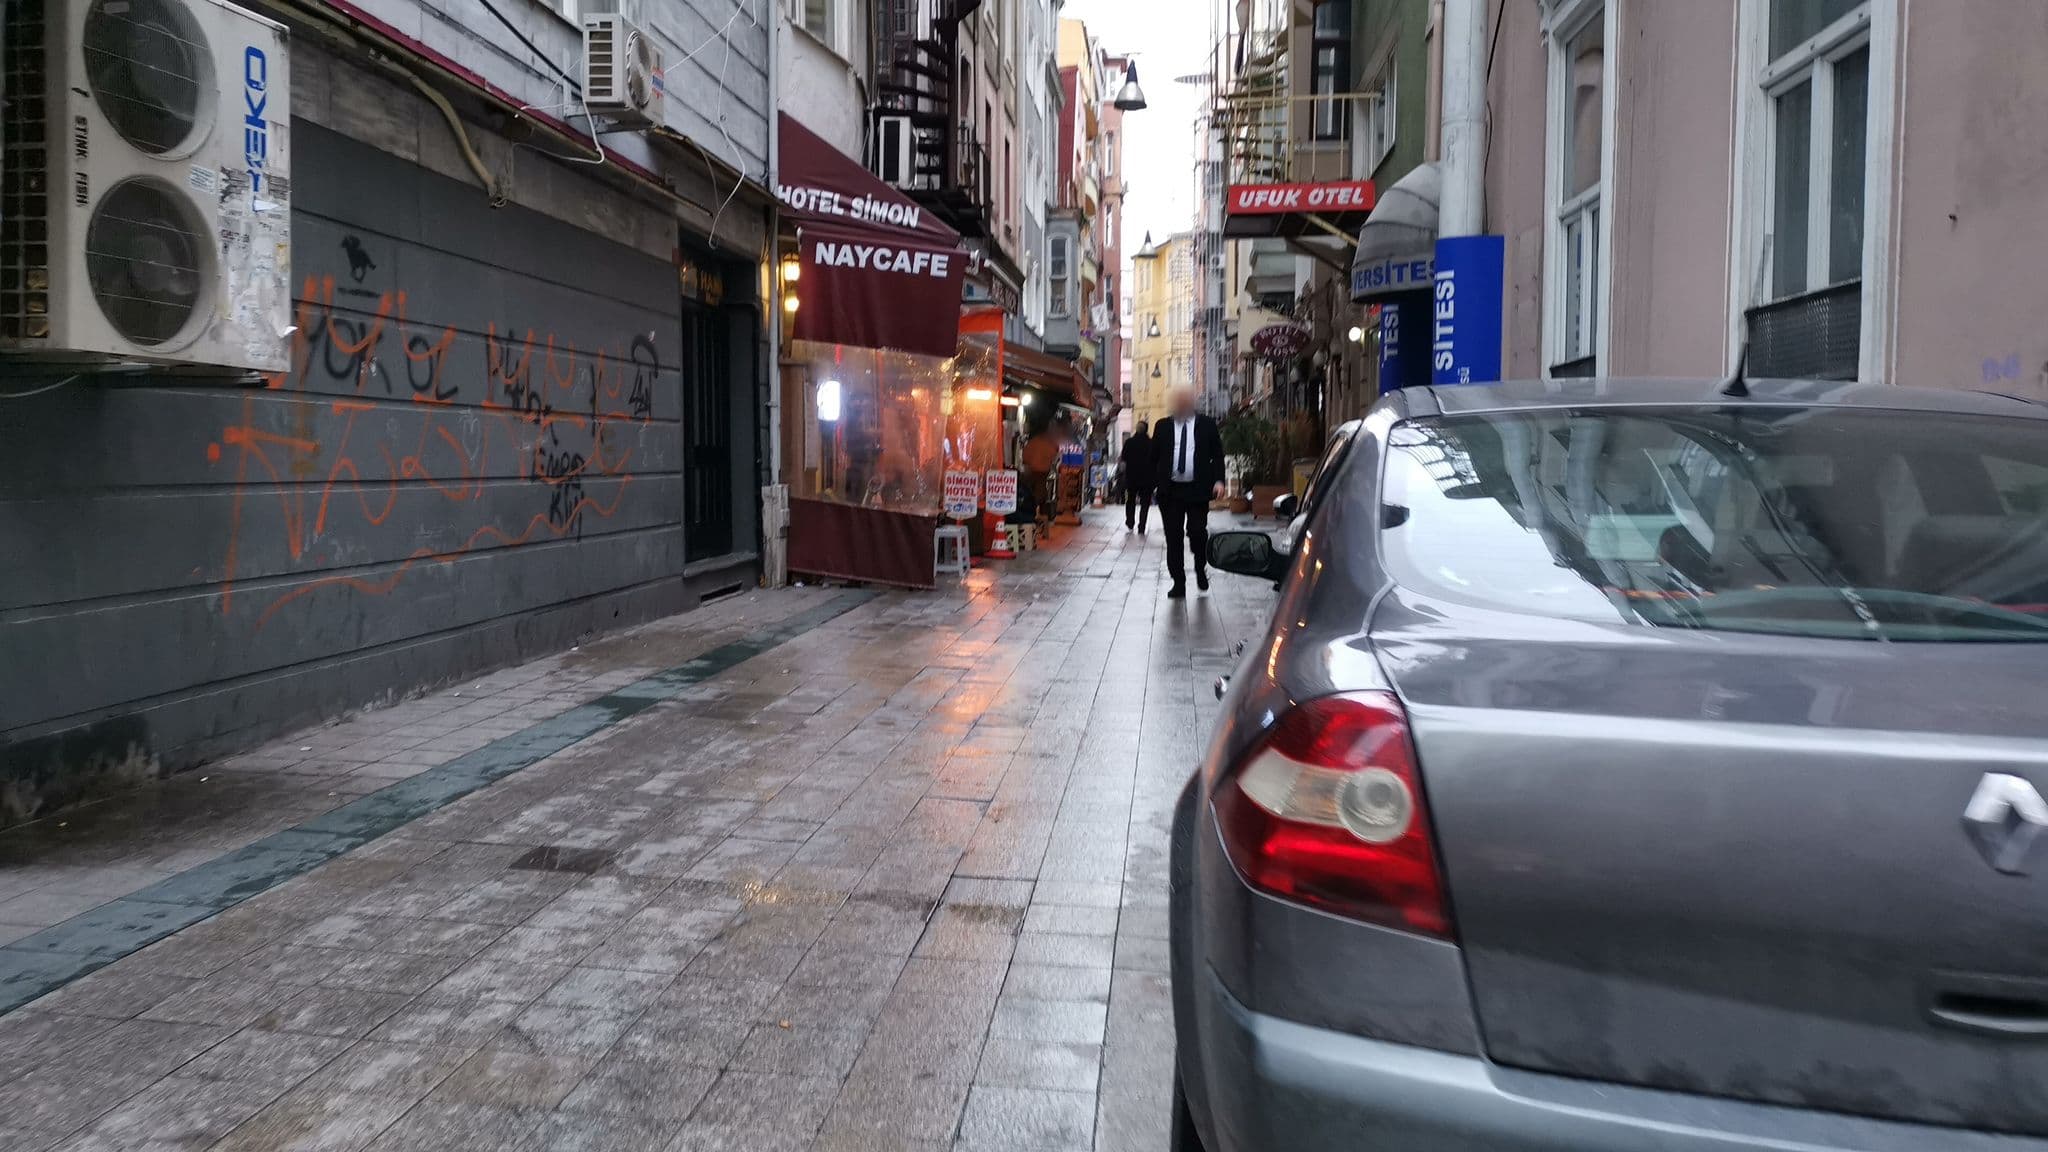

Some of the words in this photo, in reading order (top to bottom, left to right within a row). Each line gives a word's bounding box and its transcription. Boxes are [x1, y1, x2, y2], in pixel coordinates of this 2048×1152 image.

[75, 115, 89, 159] STINK
[245, 45, 267, 213] EKO
[777, 184, 844, 215] HOTEL
[850, 192, 921, 228] SİMON
[1238, 188, 1304, 208] UFUK
[1307, 186, 1364, 206] OTEL
[815, 241, 950, 278] NAYCAFE
[946, 486, 977, 497] HOTEL
[988, 484, 1015, 495] HOTEL
